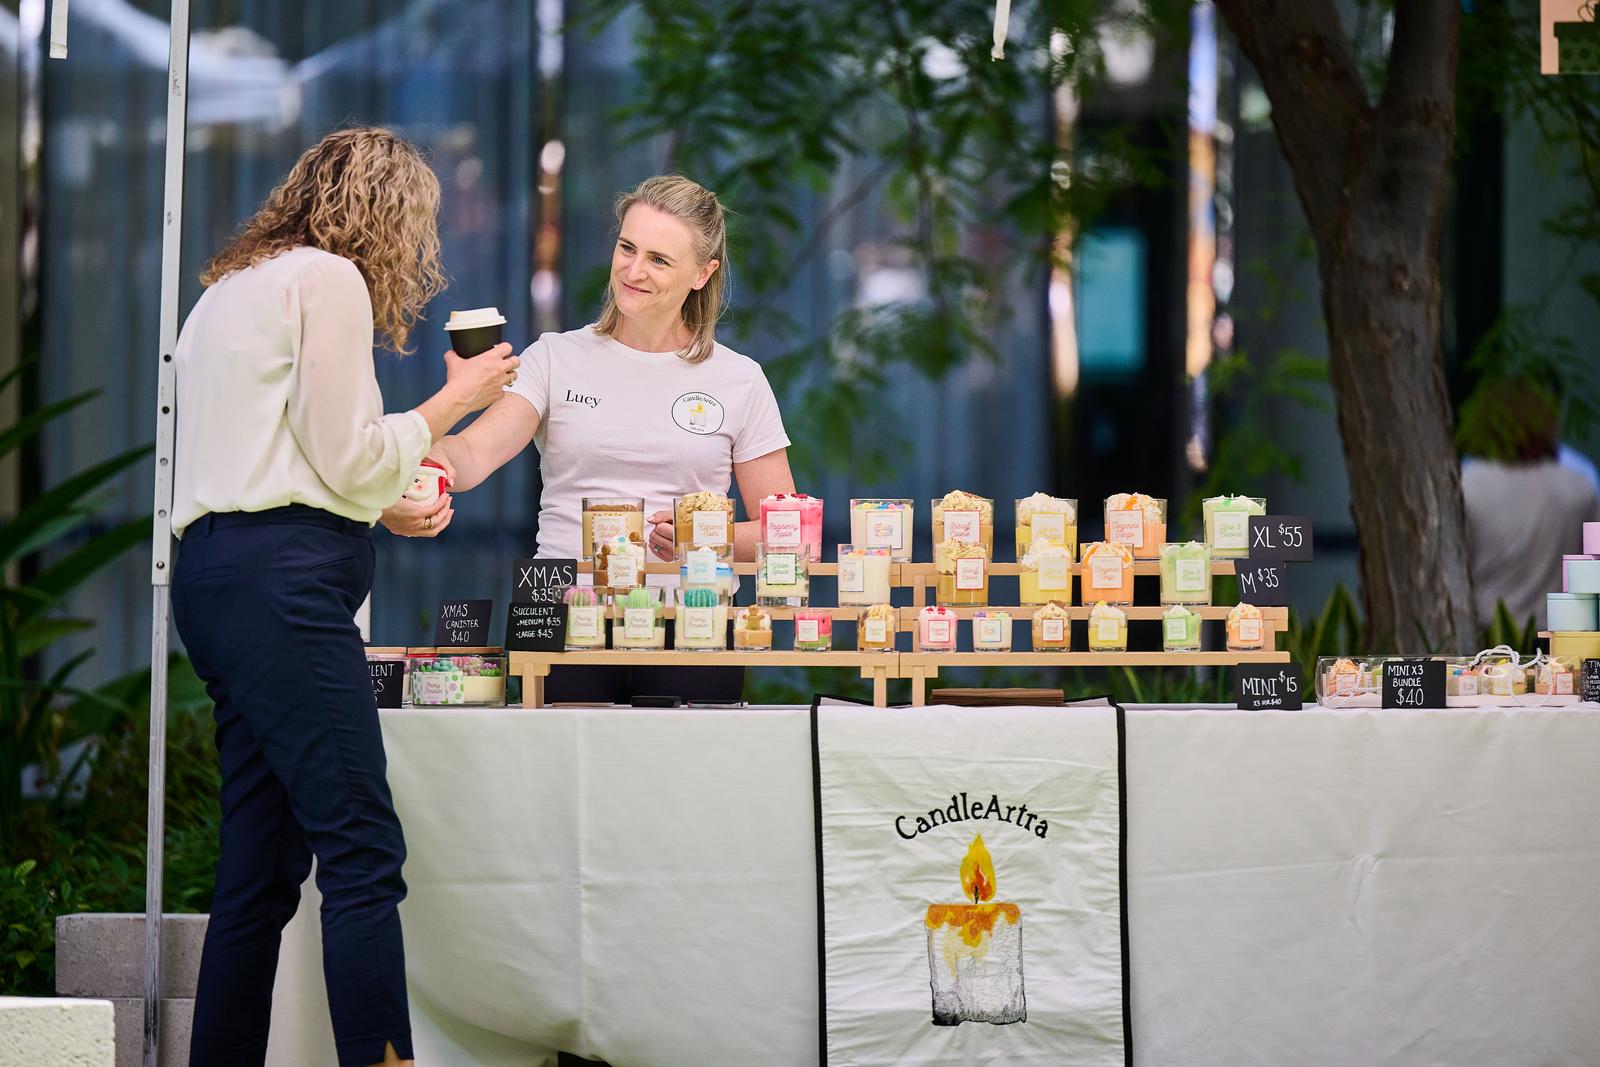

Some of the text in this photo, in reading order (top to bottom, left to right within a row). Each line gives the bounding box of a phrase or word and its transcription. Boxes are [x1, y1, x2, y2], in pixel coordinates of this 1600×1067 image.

[566, 390, 602, 408] Lucy
[1253, 526, 1276, 548] XL
[1278, 523, 1303, 547] $55
[518, 565, 573, 588] XMAS
[1240, 568, 1280, 594] M $35
[441, 603, 469, 619] XMAS
[512, 606, 555, 617] SUCCULENT
[445, 619, 480, 630] CANISTER
[546, 617, 561, 627] $35
[450, 630, 470, 643] $40
[537, 628, 553, 639] $45
[368, 663, 395, 677] LENT
[1387, 665, 1409, 677] MINI
[1242, 670, 1298, 697] MINI $15
[1392, 677, 1422, 687] BUNDLE
[1395, 687, 1424, 706] $40
[895, 792, 1049, 840] CandleArtra
